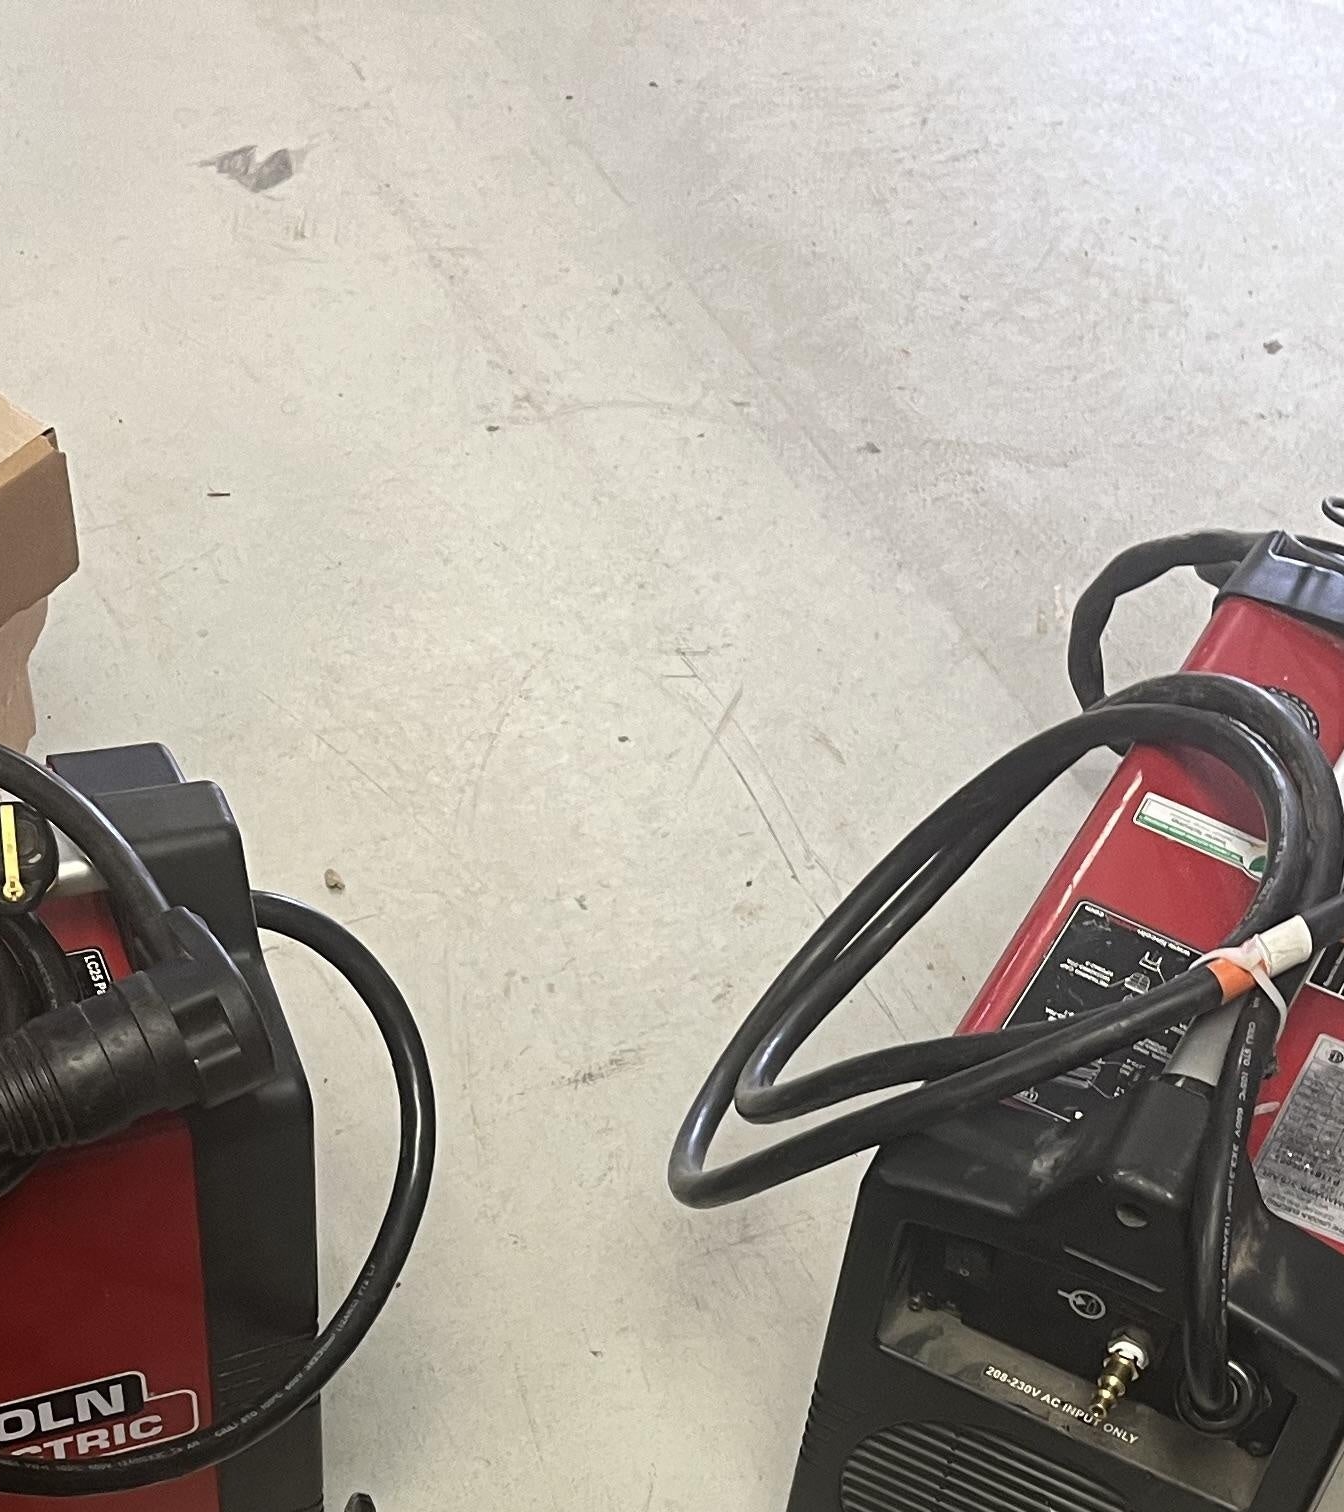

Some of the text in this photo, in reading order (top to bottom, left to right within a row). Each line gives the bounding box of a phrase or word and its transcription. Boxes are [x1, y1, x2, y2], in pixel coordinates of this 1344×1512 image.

[984, 1364, 1138, 1445] 208-230V AC INPUT ONLY
